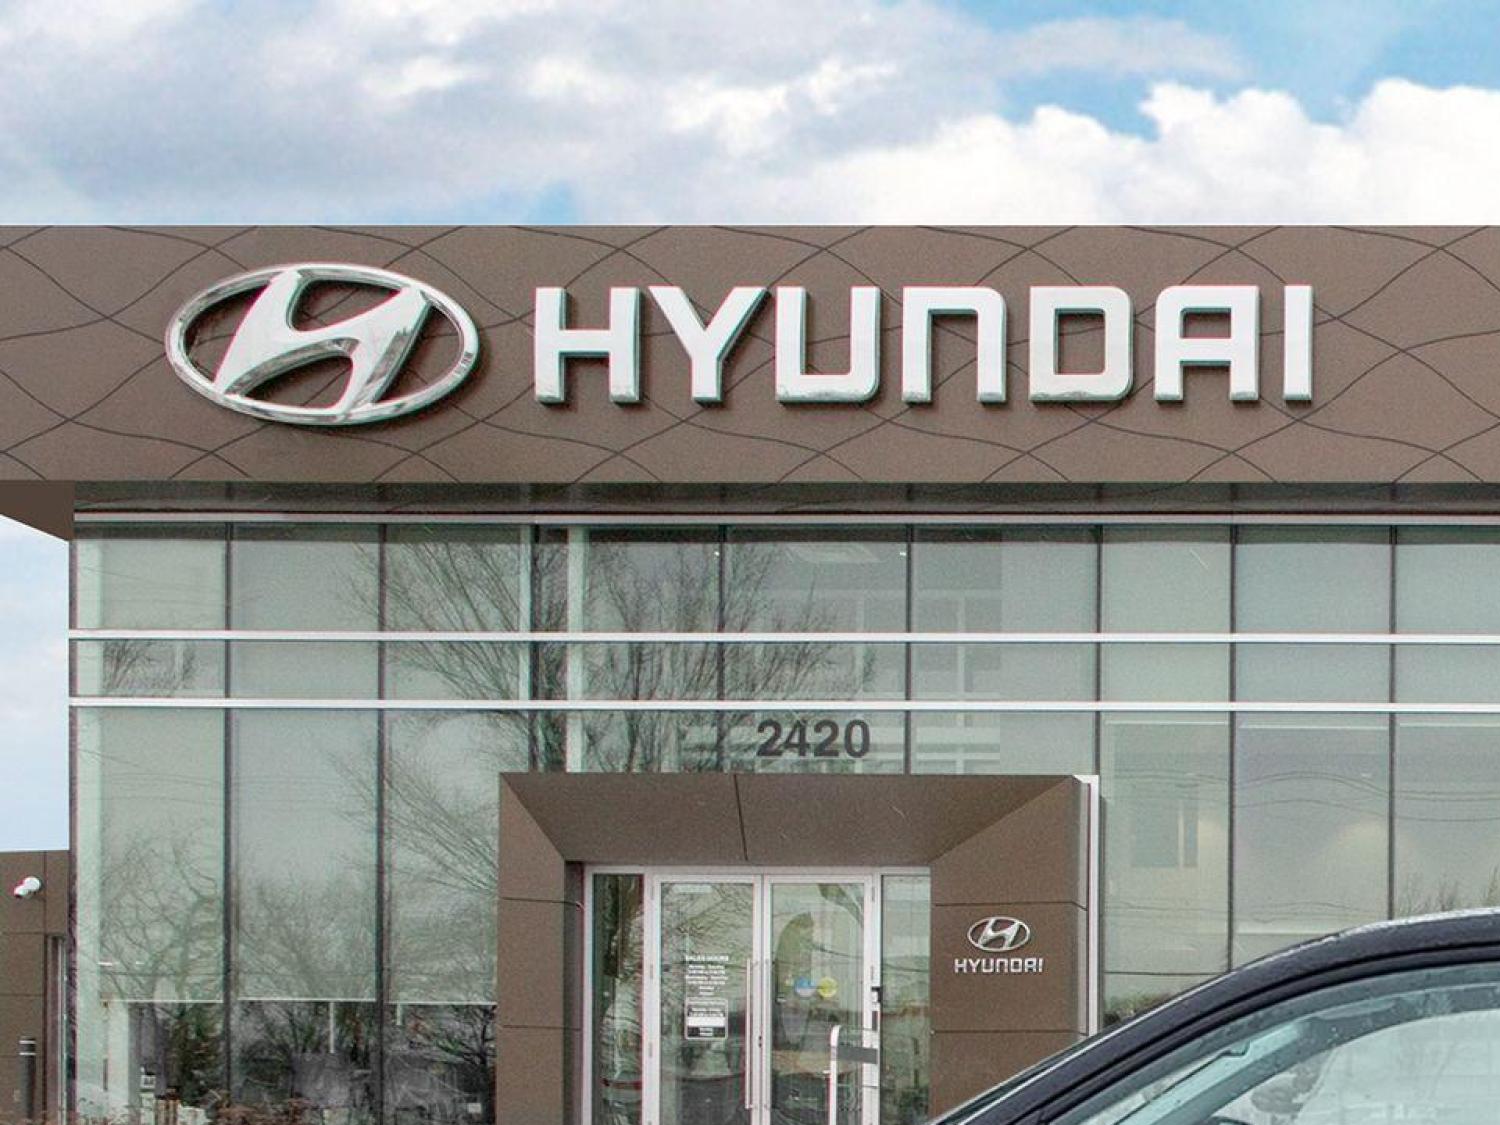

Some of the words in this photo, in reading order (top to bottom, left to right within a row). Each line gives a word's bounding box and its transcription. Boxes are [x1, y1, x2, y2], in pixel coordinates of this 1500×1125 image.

[533, 284, 1314, 403] HYUNDAI
[756, 718, 871, 759] 2420
[954, 957, 1044, 974] HYUNDAI
